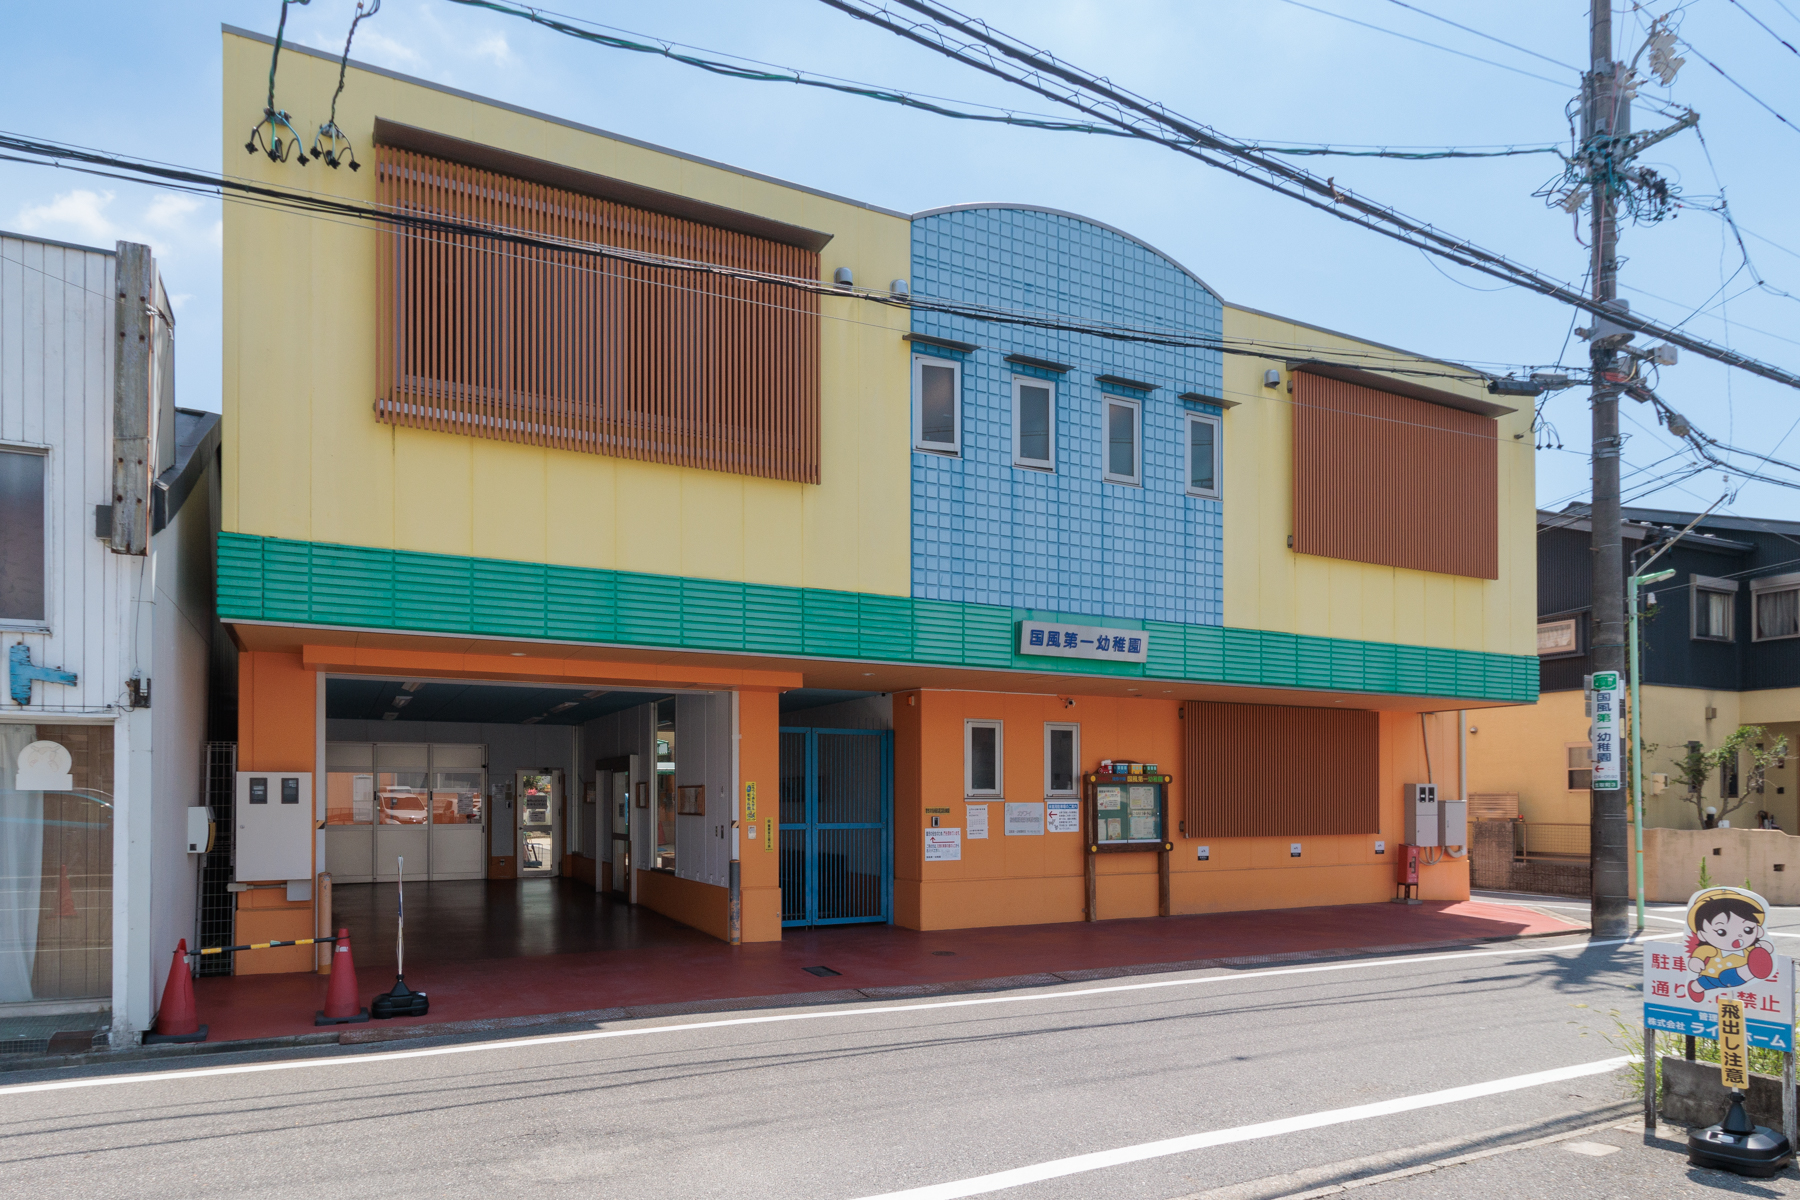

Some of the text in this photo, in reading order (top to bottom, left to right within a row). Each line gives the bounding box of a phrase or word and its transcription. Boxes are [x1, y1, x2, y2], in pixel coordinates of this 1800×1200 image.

[1029, 629, 1142, 653] 国風第一幼稚園
[1596, 692, 1612, 762] 国風第一幼稚園
[1651, 980, 1781, 1013] 通り禁止
[1647, 1017, 1686, 1031] 株式会社
[1721, 1003, 1744, 1084] 飛出し注意
